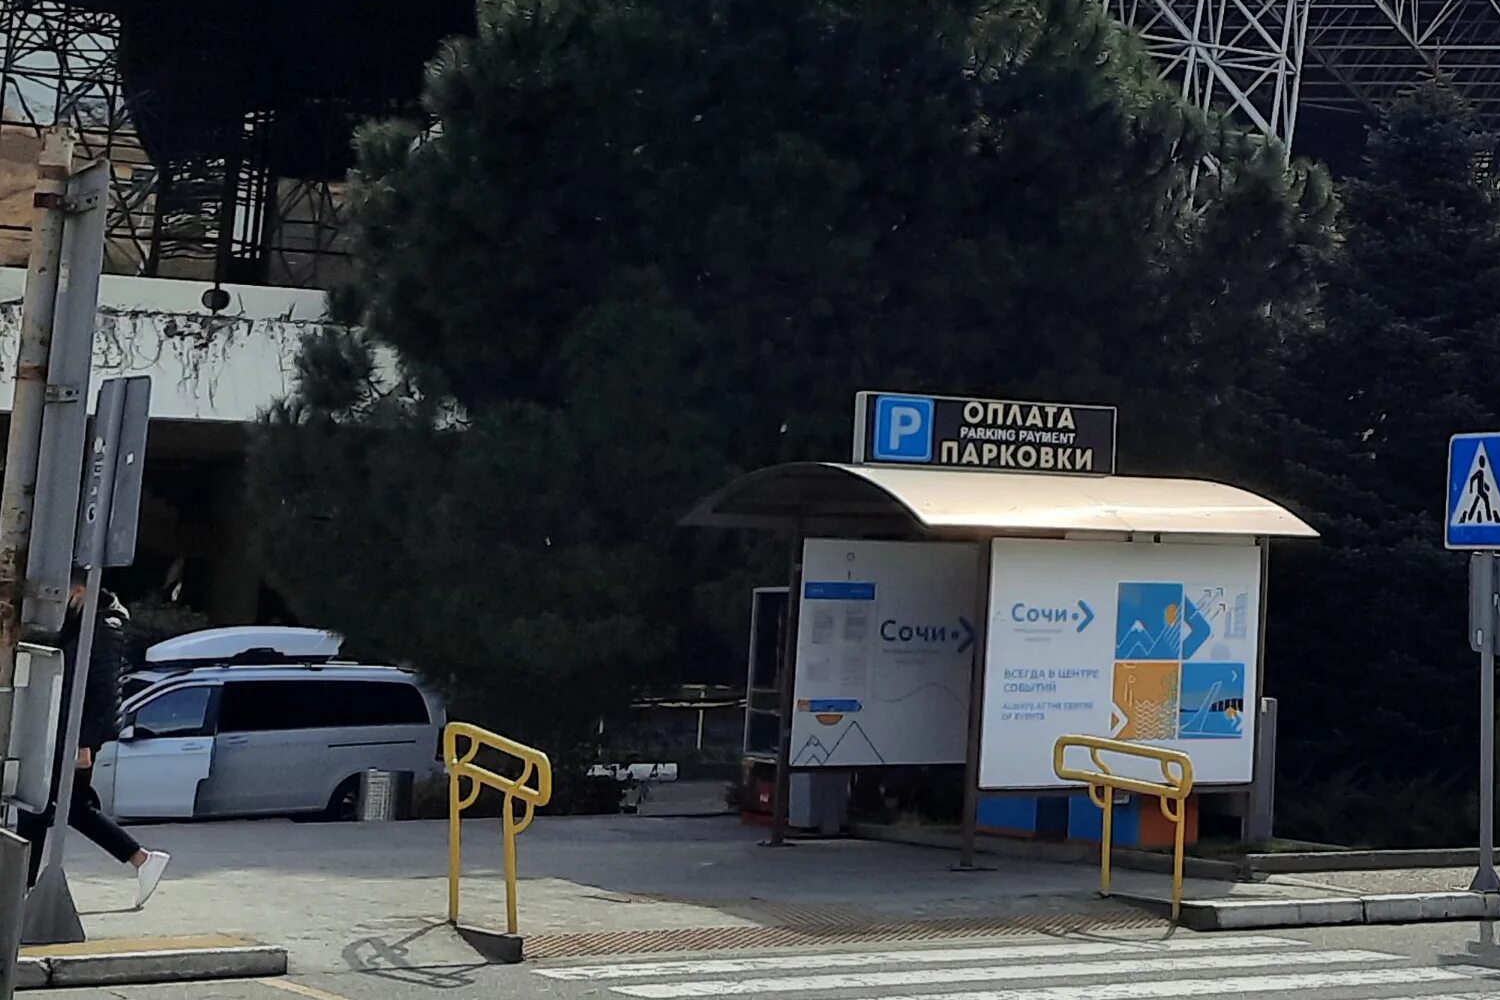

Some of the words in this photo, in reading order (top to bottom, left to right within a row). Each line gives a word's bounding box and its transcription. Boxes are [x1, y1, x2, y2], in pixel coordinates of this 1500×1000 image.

[963, 401, 1076, 430] ОПЛАТА
[890, 406, 922, 450] P
[960, 426, 1016, 441] PARKING
[1018, 429, 1076, 444] PAYMENT
[940, 440, 1093, 471] ПАРКОВКИ
[1011, 602, 1068, 623] Сочи
[879, 619, 946, 642] Сочи
[1004, 668, 1046, 680] ВСЕГДА
[1048, 669, 1056, 679] В
[1058, 668, 1100, 680] ЦЕНТРЕ
